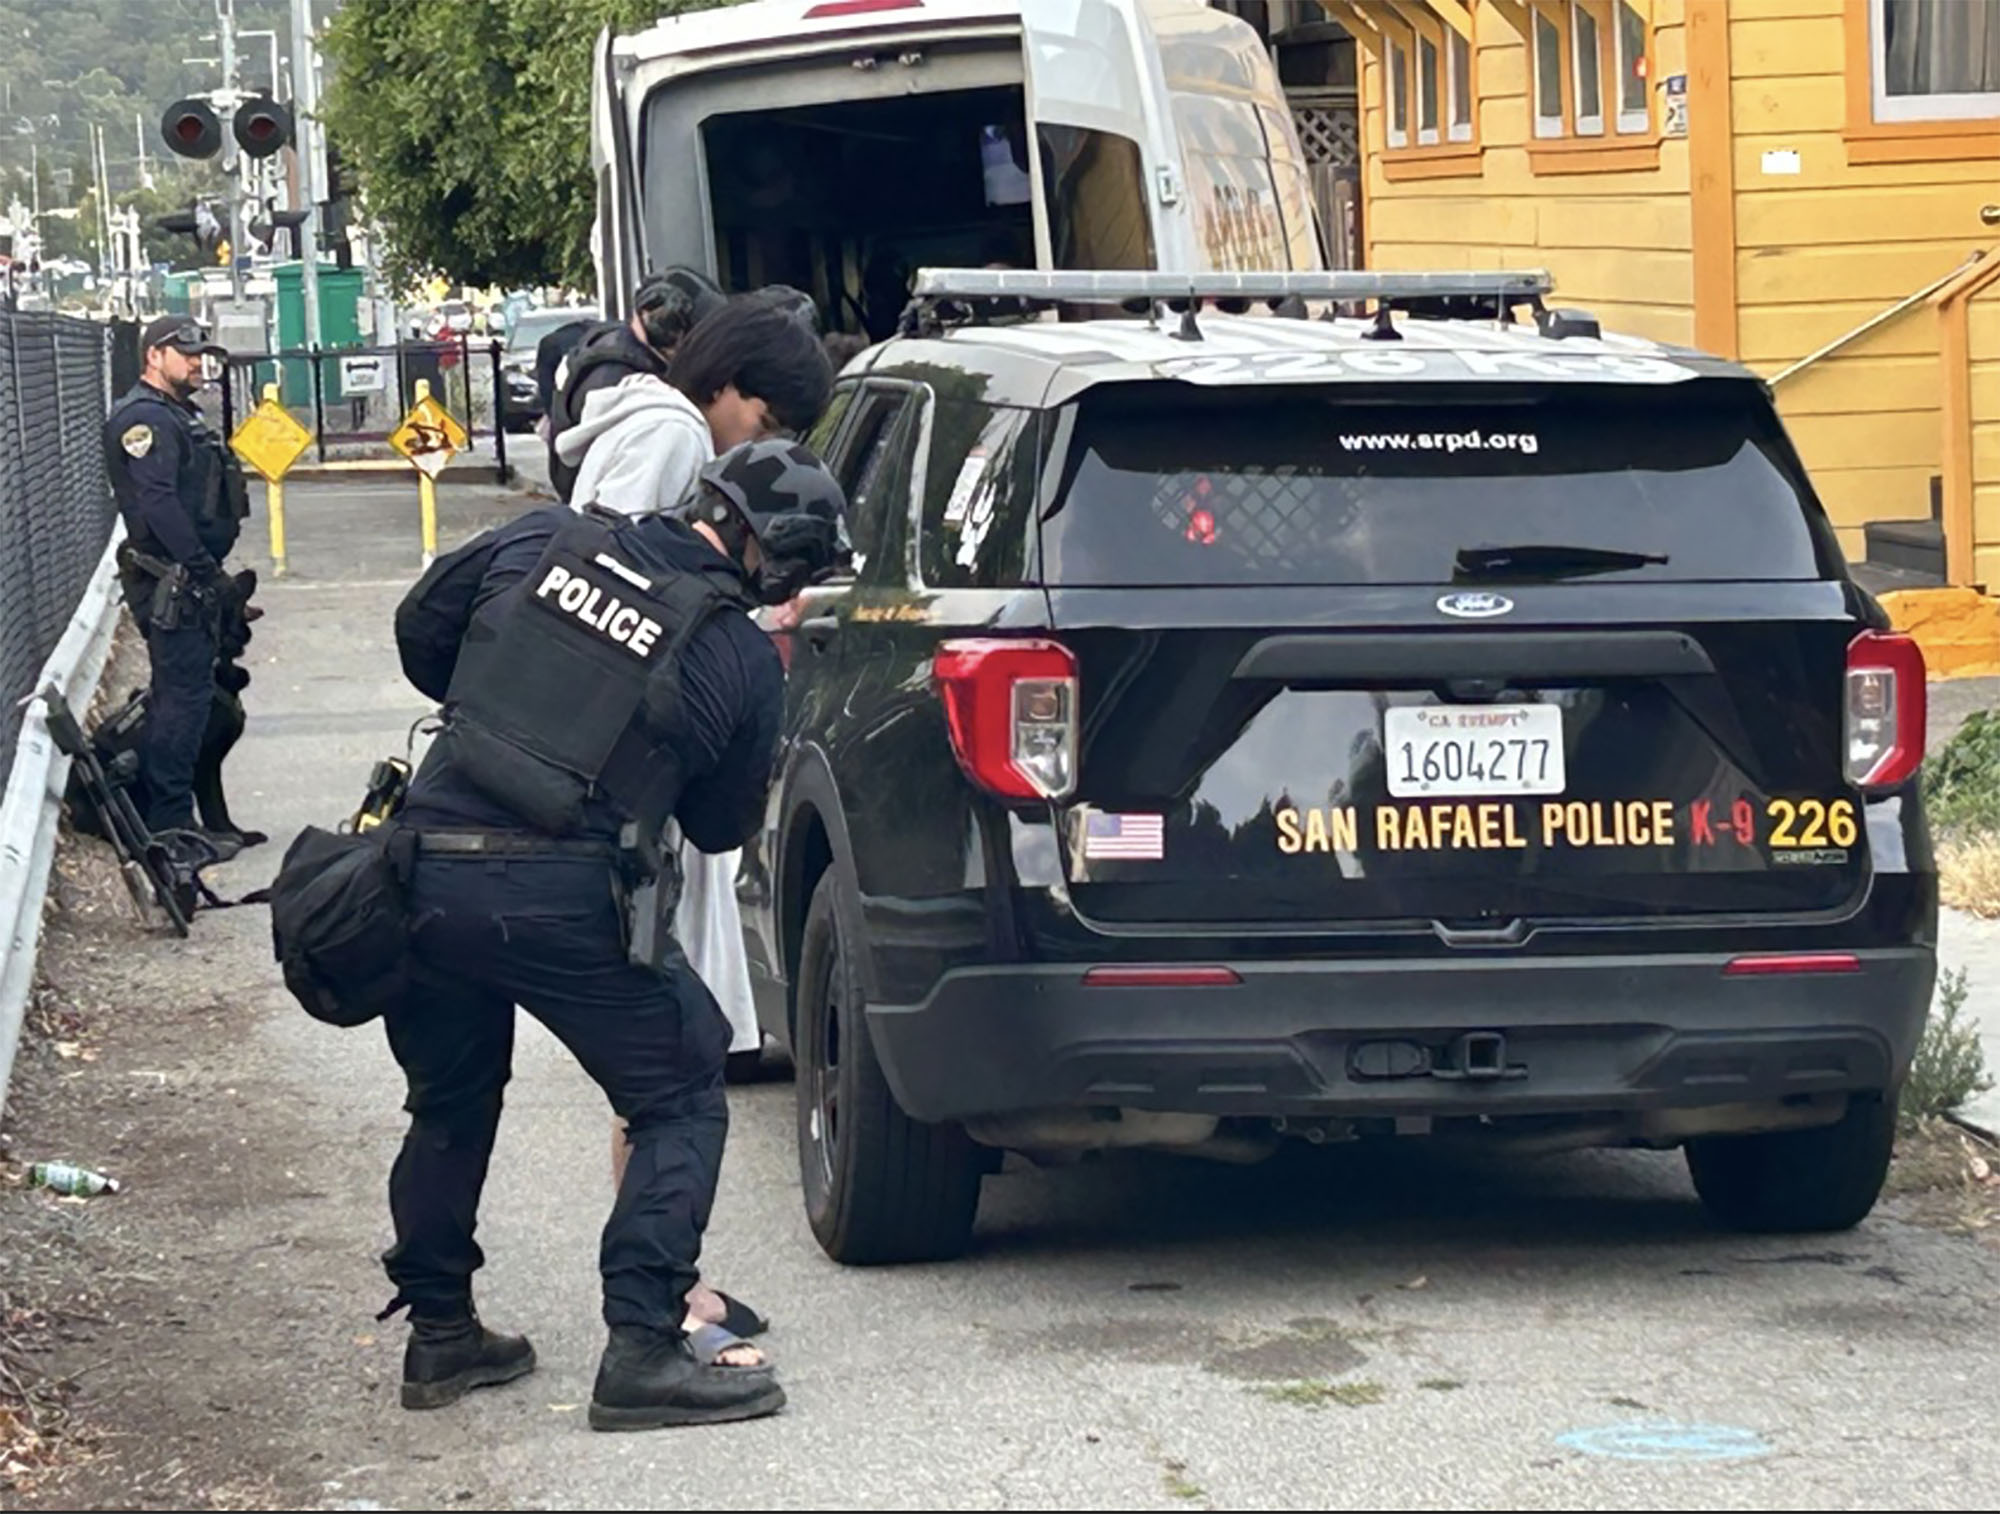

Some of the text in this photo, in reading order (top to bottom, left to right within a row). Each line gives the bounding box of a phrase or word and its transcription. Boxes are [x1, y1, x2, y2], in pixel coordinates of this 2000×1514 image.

[1165, 352, 1426, 384] 226
[1339, 429, 1539, 454] www.srpd.org
[536, 566, 663, 657] POLICE
[1429, 714, 1450, 727] CA
[1401, 739, 1550, 782] 1604277
[1276, 798, 1857, 854] SAN RAFAEL POLICE K-9 226
